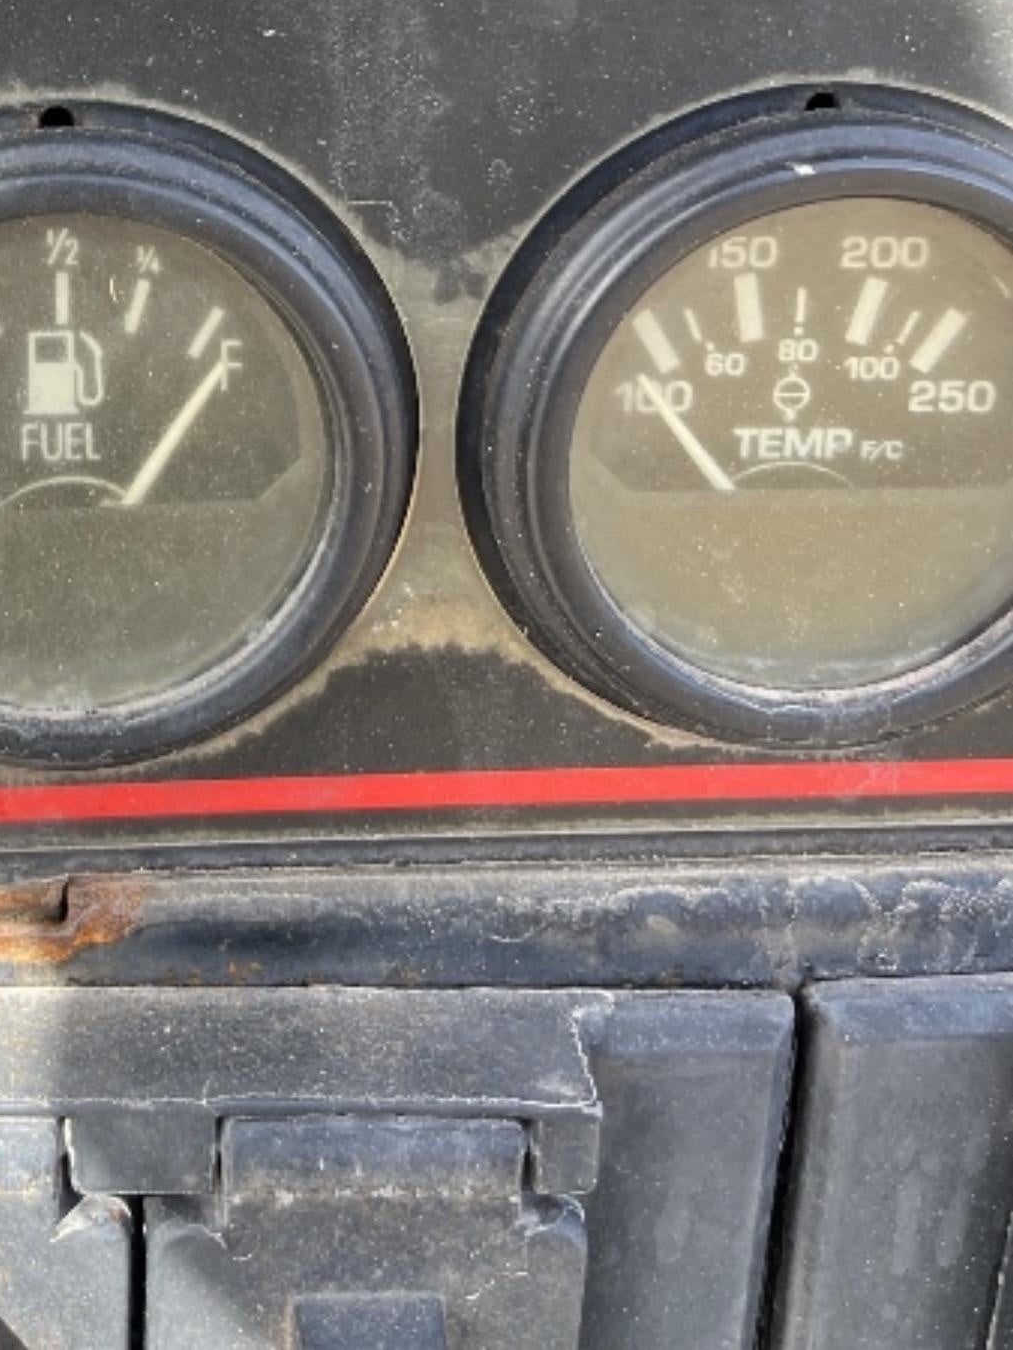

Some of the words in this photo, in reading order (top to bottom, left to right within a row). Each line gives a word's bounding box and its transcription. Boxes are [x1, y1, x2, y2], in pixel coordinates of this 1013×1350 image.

[707, 236, 779, 269] 150
[839, 237, 930, 269] 200
[219, 340, 243, 392] F
[704, 352, 745, 378] 60
[778, 338, 818, 363] 80
[846, 355, 899, 381] 100
[614, 380, 694, 414] 100
[907, 380, 996, 414] 250
[20, 422, 102, 461] FUEL
[733, 428, 852, 460] TEMP
[859, 439, 905, 461] F/C
